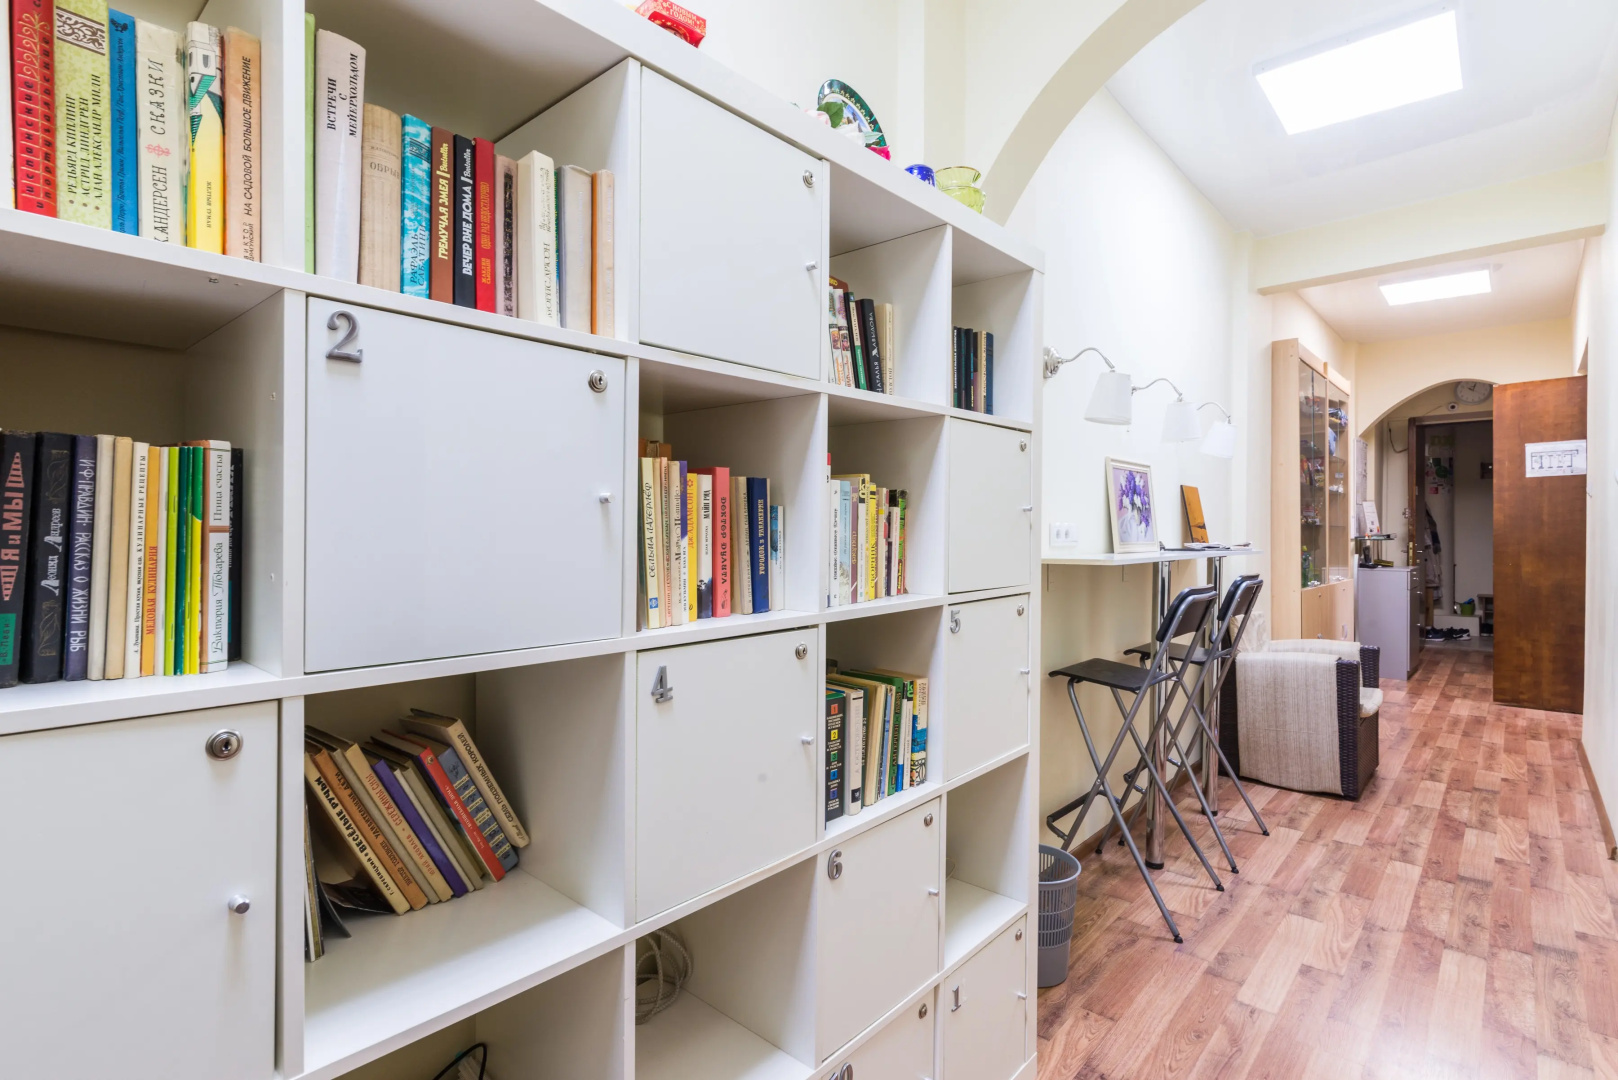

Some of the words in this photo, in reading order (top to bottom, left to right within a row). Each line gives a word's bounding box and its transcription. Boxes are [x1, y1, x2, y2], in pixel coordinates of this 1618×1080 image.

[670, 9, 695, 26] ГОДОМ!
[672, 4, 697, 22] НОВЫМ
[91, 74, 101, 107] МИЛН
[148, 58, 166, 135] СКАЗКИ
[242, 56, 252, 107] ДВИЖЕНИЕ
[347, 51, 360, 138] МЕЙЕРХОЛЬДОМ
[41, 35, 53, 199] португальские
[66, 94, 76, 148] КИПЛИНГ
[327, 77, 337, 131] ВСТРЕЧИ
[24, 81, 35, 194] испанские
[79, 97, 90, 156] ЛИНДГРЕН
[92, 108, 103, 170] АЛЕКСАНДР
[242, 107, 252, 152] БОЛЬШОЕ
[67, 151, 78, 195] РЕДЬЯРД
[80, 158, 90, 197] АСТРИД
[93, 173, 103, 201] АЛАН
[241, 155, 253, 201] САДОВОЙ
[438, 177, 449, 206] ЗМЕЯ
[243, 203, 253, 217] НА
[462, 186, 474, 223] ДОМА
[438, 207, 449, 260] ГРЕМУЧАЯ
[462, 222, 472, 243] ВНЕ
[480, 222, 490, 233] РАЗ
[410, 233, 419, 284] РАФАЭЛЬ
[418, 225, 426, 287] САБАТИНИ
[462, 244, 473, 276] ВЕЧЕР
[325, 310, 363, 363] 2
[138, 455, 146, 494] РЕЦЕПТЫ
[215, 454, 223, 489] счастья
[2, 491, 24, 531] МЫ
[213, 491, 223, 521] Птица
[702, 502, 710, 519] МАЙН
[703, 489, 711, 501] РИД
[136, 497, 145, 553] КУЛИНАРНЫЕ
[720, 497, 728, 539] ДОКТОР
[757, 499, 765, 538] ТАБАКЕРКЕ
[1, 549, 20, 561] Я
[73, 531, 92, 570] РАССКАЗ
[147, 546, 158, 594] КУЛИНАРИЯ
[211, 542, 225, 596] Токарева
[40, 555, 61, 597] Леонид
[71, 588, 89, 624] ЖИЗНИ
[146, 598, 156, 635] МЕДОВАЯ
[949, 610, 961, 634] 5
[70, 630, 88, 652] РЫБ
[211, 599, 224, 654] Виктория
[651, 665, 673, 703] 4
[457, 731, 480, 764] КОРОЛЕЙ
[314, 775, 339, 810] РУЧЬИ
[335, 771, 350, 791] ДЕТИ
[365, 773, 380, 791] СНЫ
[476, 762, 504, 805] ПОДЗЕМНЫХ
[348, 793, 381, 840] УДИВИТЕЛЬНЫЕ
[375, 788, 403, 826] СЕРЁЖИНЫ
[501, 804, 514, 823] СЕМЬ
[336, 808, 367, 854] ВЕСЁЛЫЕ
[405, 833, 424, 860] ЯКОВЛЕВ
[827, 849, 843, 880] 6
[951, 984, 962, 1012] 1
